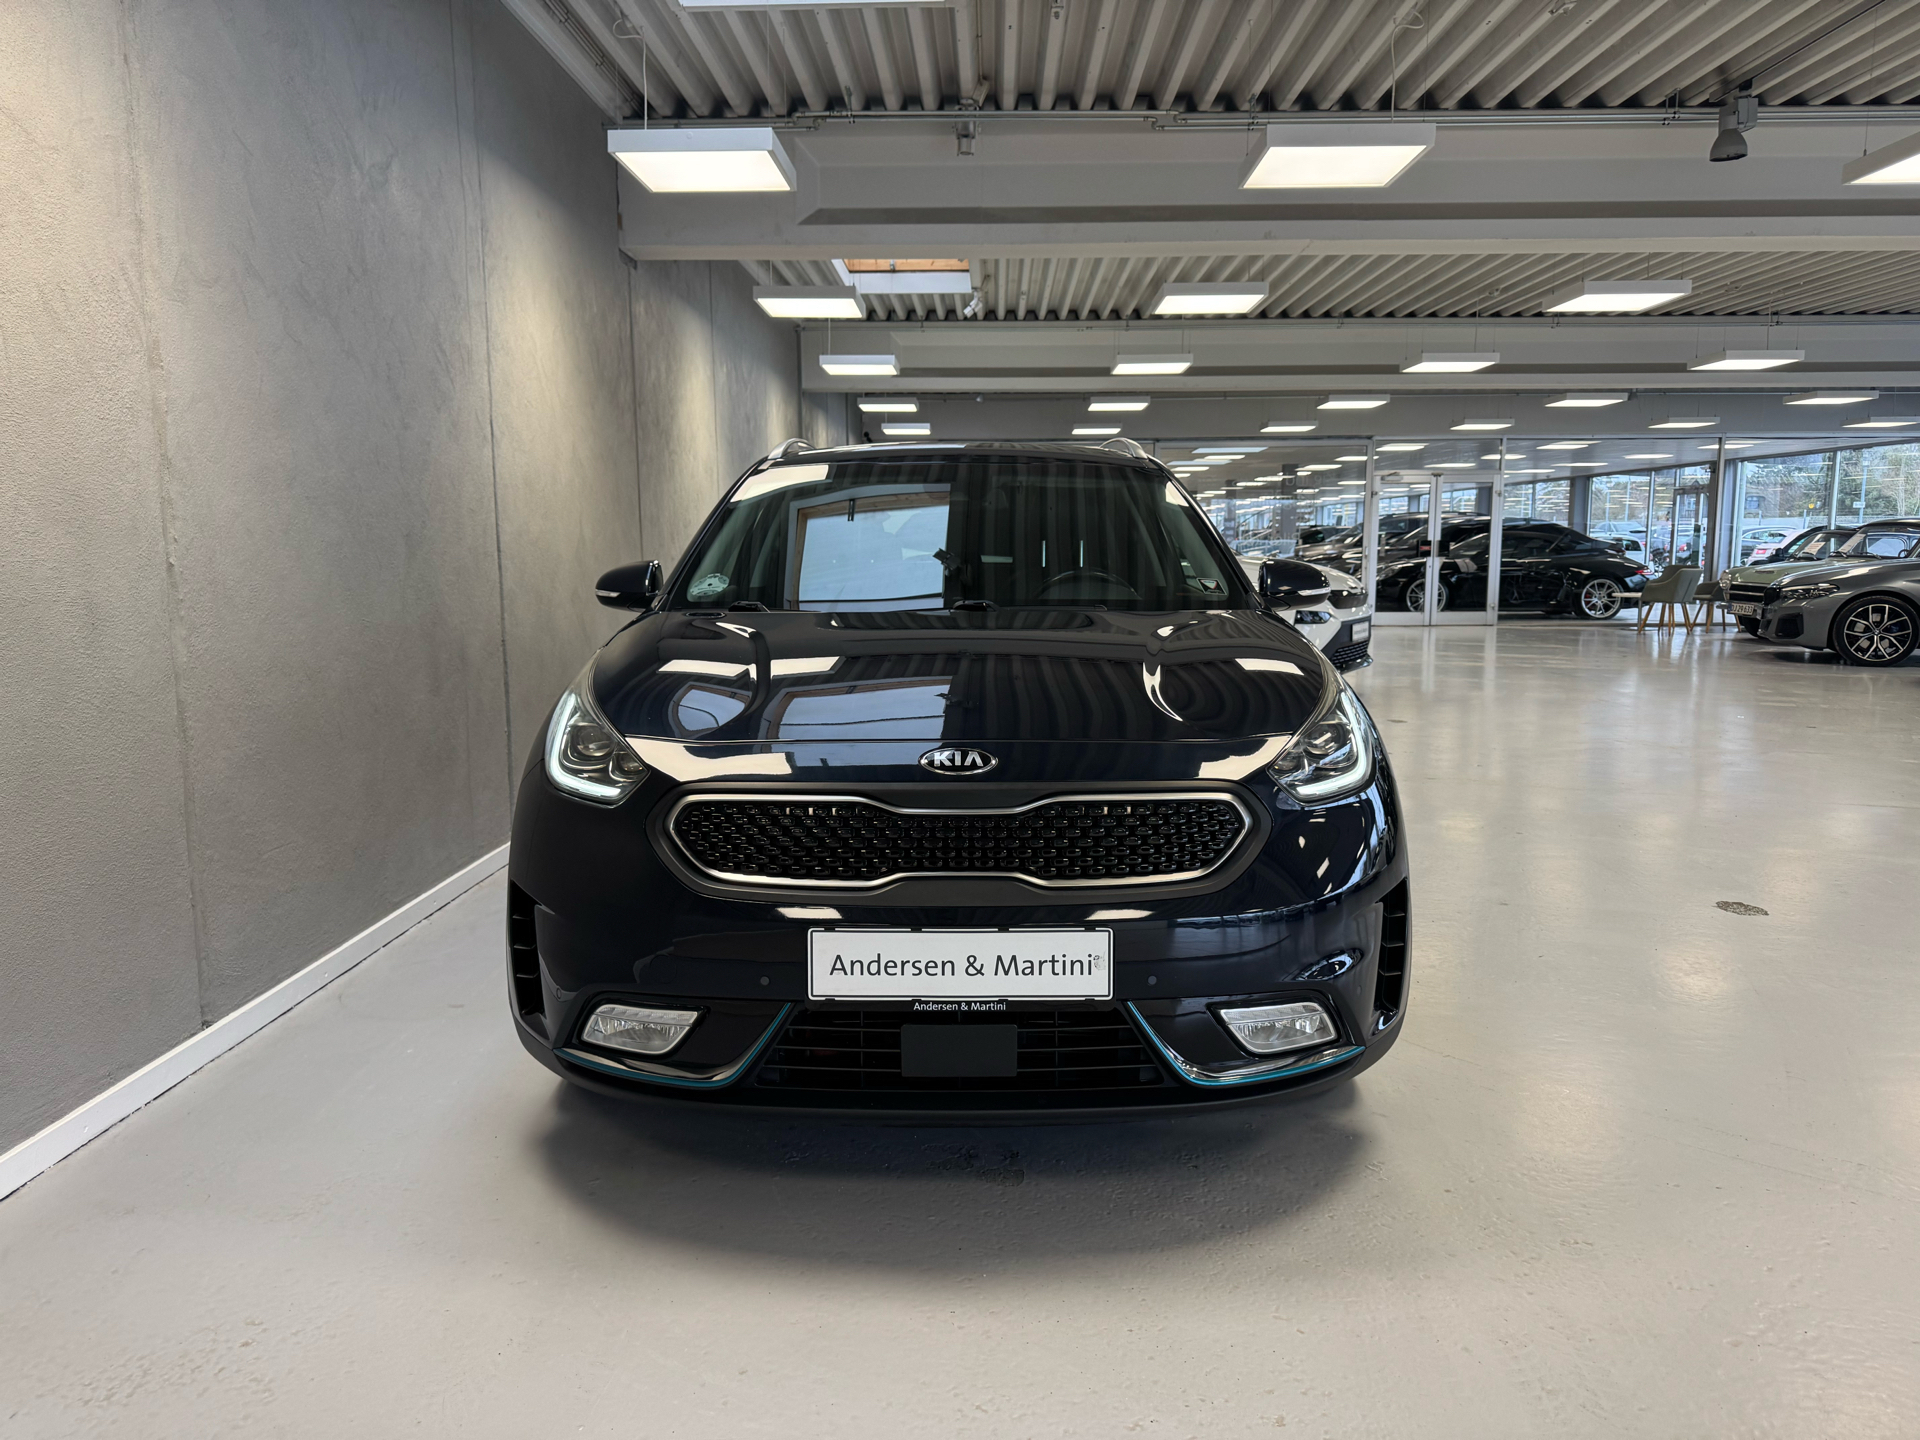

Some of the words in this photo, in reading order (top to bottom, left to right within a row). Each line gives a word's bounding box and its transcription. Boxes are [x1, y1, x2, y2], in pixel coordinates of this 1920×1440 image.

[933, 750, 984, 767] KIA
[829, 953, 956, 976] Andersen
[964, 954, 985, 977] &
[993, 953, 1093, 976] Martini
[913, 1002, 959, 1011] Andersen
[960, 1002, 969, 1011] &
[970, 1002, 1007, 1011] Martini
